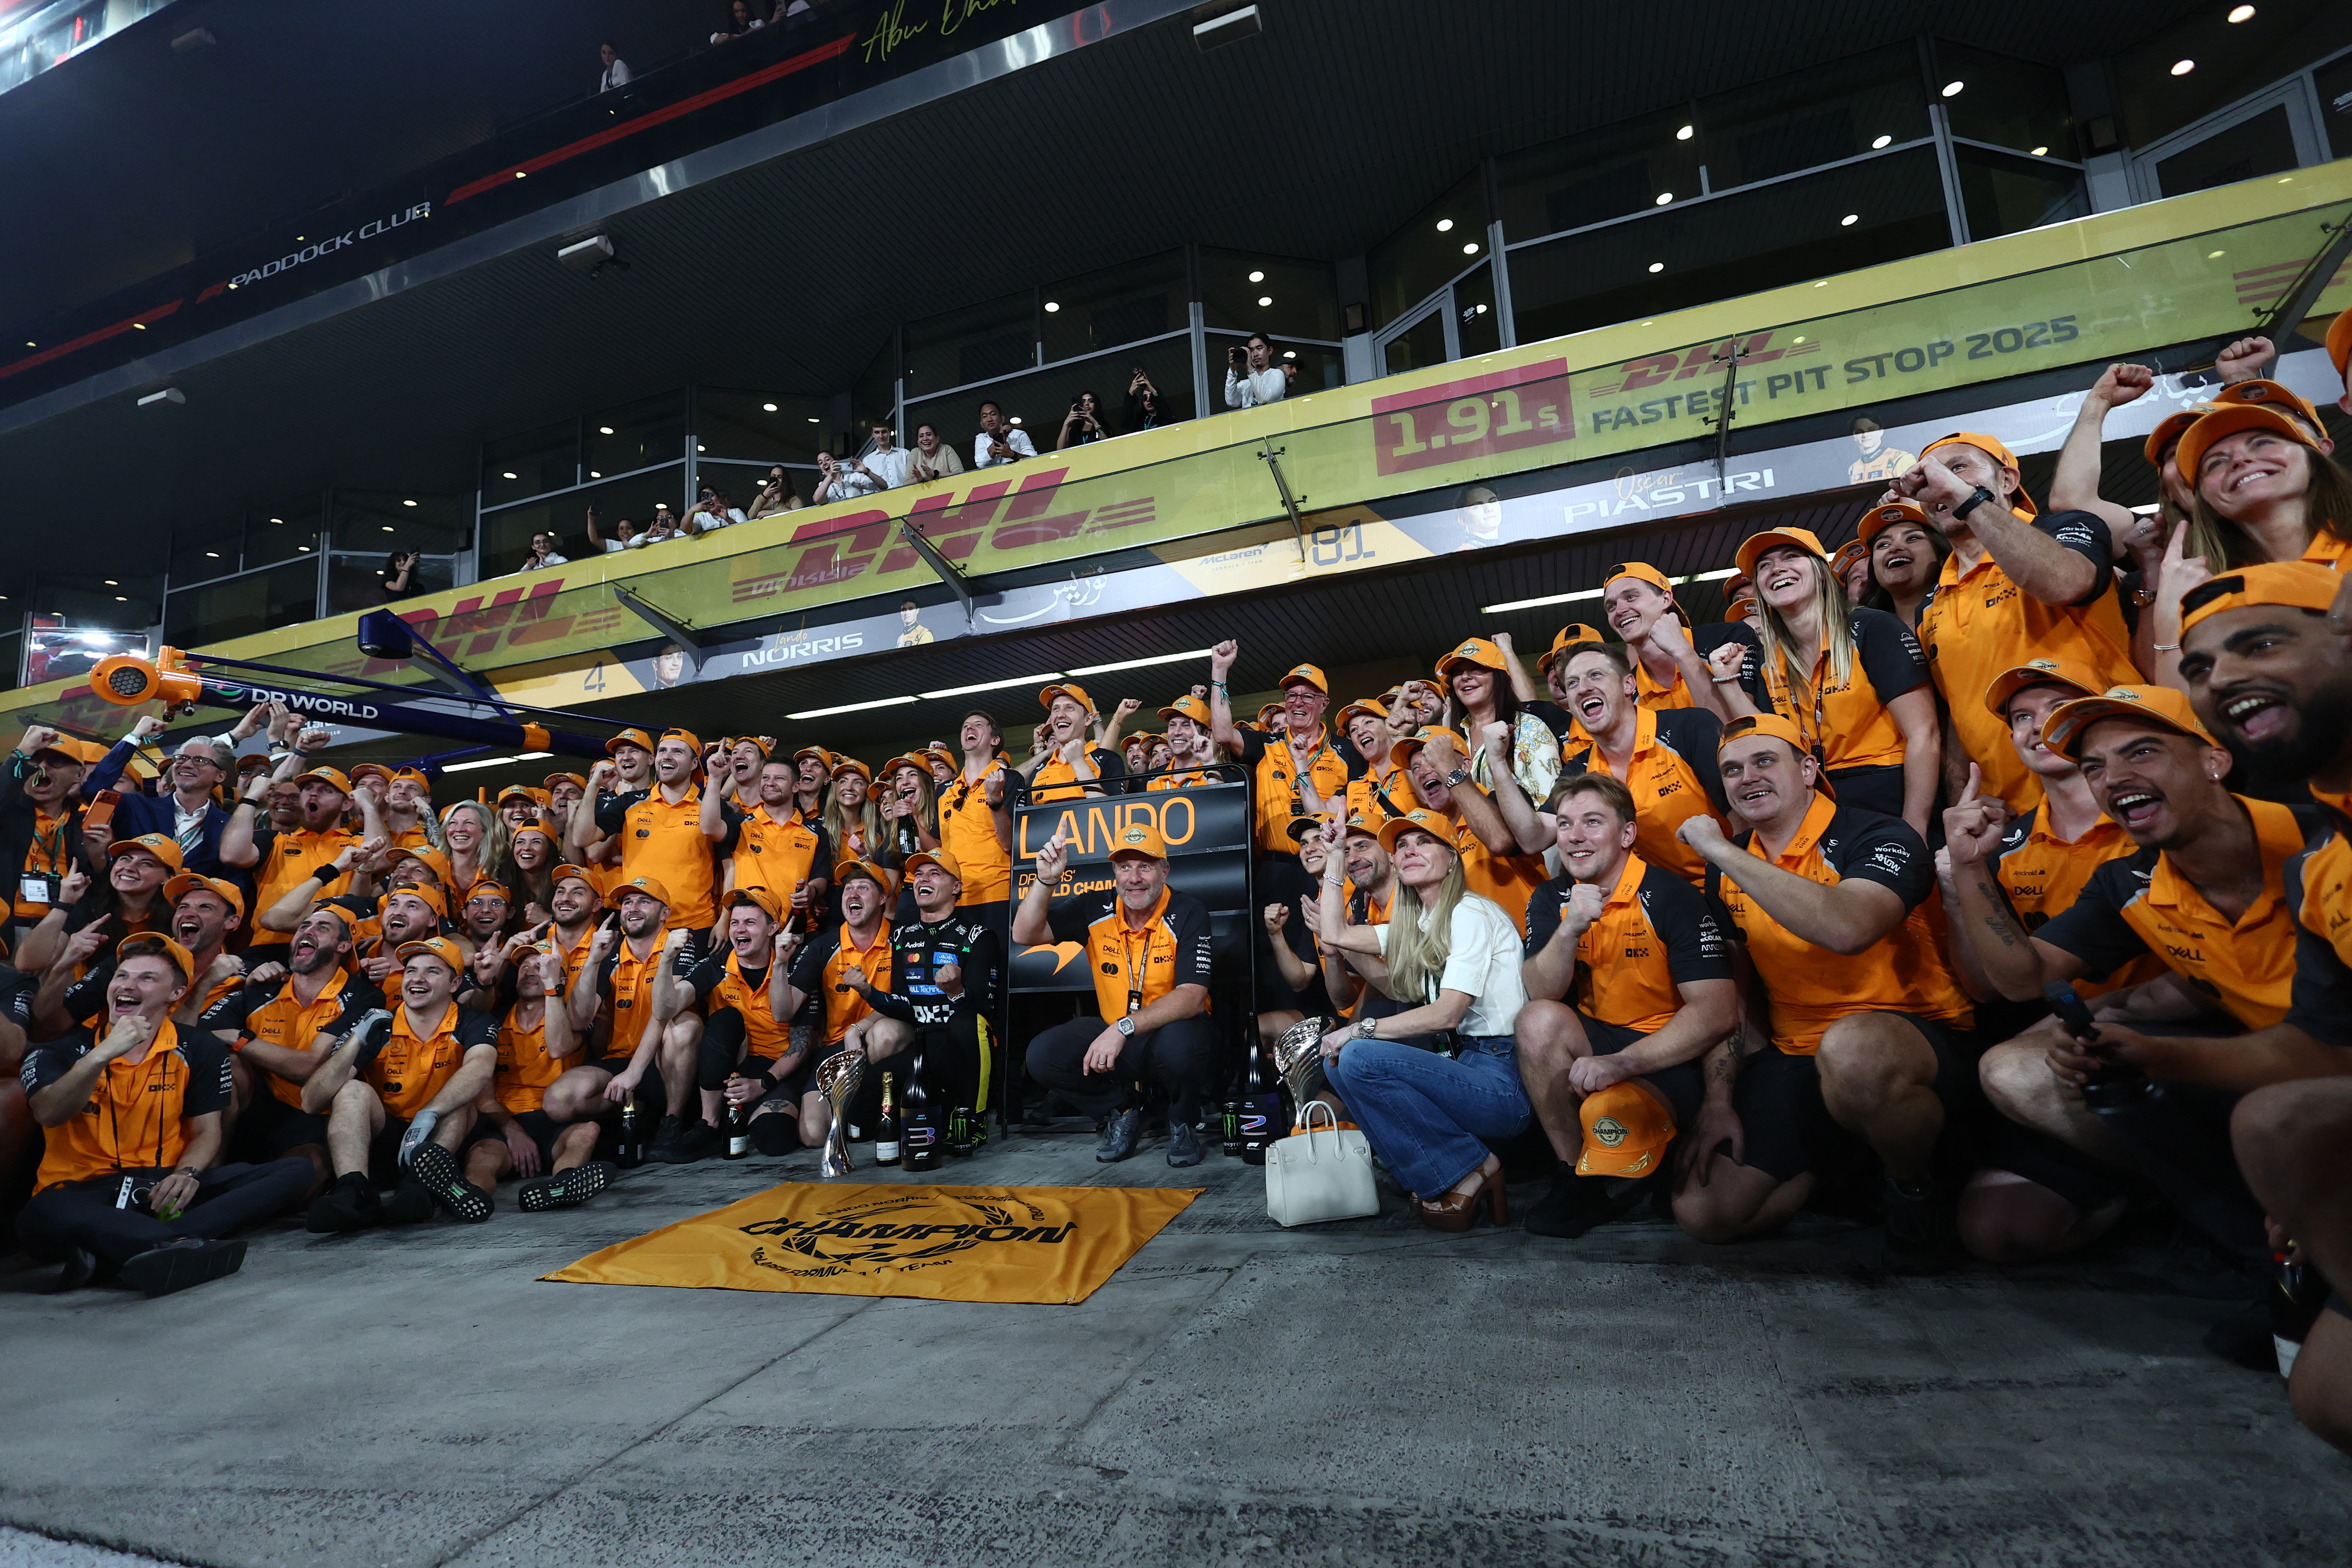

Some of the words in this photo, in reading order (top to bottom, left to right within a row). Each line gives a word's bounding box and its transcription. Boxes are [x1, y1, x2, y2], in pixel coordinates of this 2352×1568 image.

[861, 0, 928, 63] Abu
[230, 230, 354, 287] PADDOCK
[359, 201, 431, 240] CLUB
[1592, 379, 1757, 434] FASTEST
[1767, 365, 1833, 399] PIT
[1844, 341, 1955, 384] STOP
[1965, 314, 2080, 360] 2025
[1620, 332, 1786, 392] DHL
[1563, 468, 1775, 524] PIASTRI
[1613, 466, 1683, 501] Oscar
[781, 466, 1081, 593] DHL
[1311, 519, 1376, 567] 81
[1199, 548, 1262, 566] McLaren
[359, 578, 577, 677] DHL
[774, 615, 808, 653] Lando
[742, 632, 863, 668] NORRIS
[584, 661, 606, 693] 4
[290, 694, 379, 719] WORLD
[1658, 780, 1682, 798] OKX
[1020, 796, 1195, 859] LANDO
[1874, 846, 1911, 858] workday
[1018, 869, 1076, 886] DRRS'
[1018, 884, 1071, 900] WLD
[1074, 879, 1117, 896] CHAM
[2014, 886, 2044, 896] DELL
[1102, 945, 1120, 955] DELL
[1578, 940, 1589, 949] LL
[1625, 947, 1649, 958] OKX
[2166, 945, 2206, 962] DELL
[1153, 955, 1174, 964] OKX
[912, 1004, 955, 1024] OKX
[739, 1217, 1078, 1243] CHAMPION
[899, 1259, 953, 1272] TEAM
